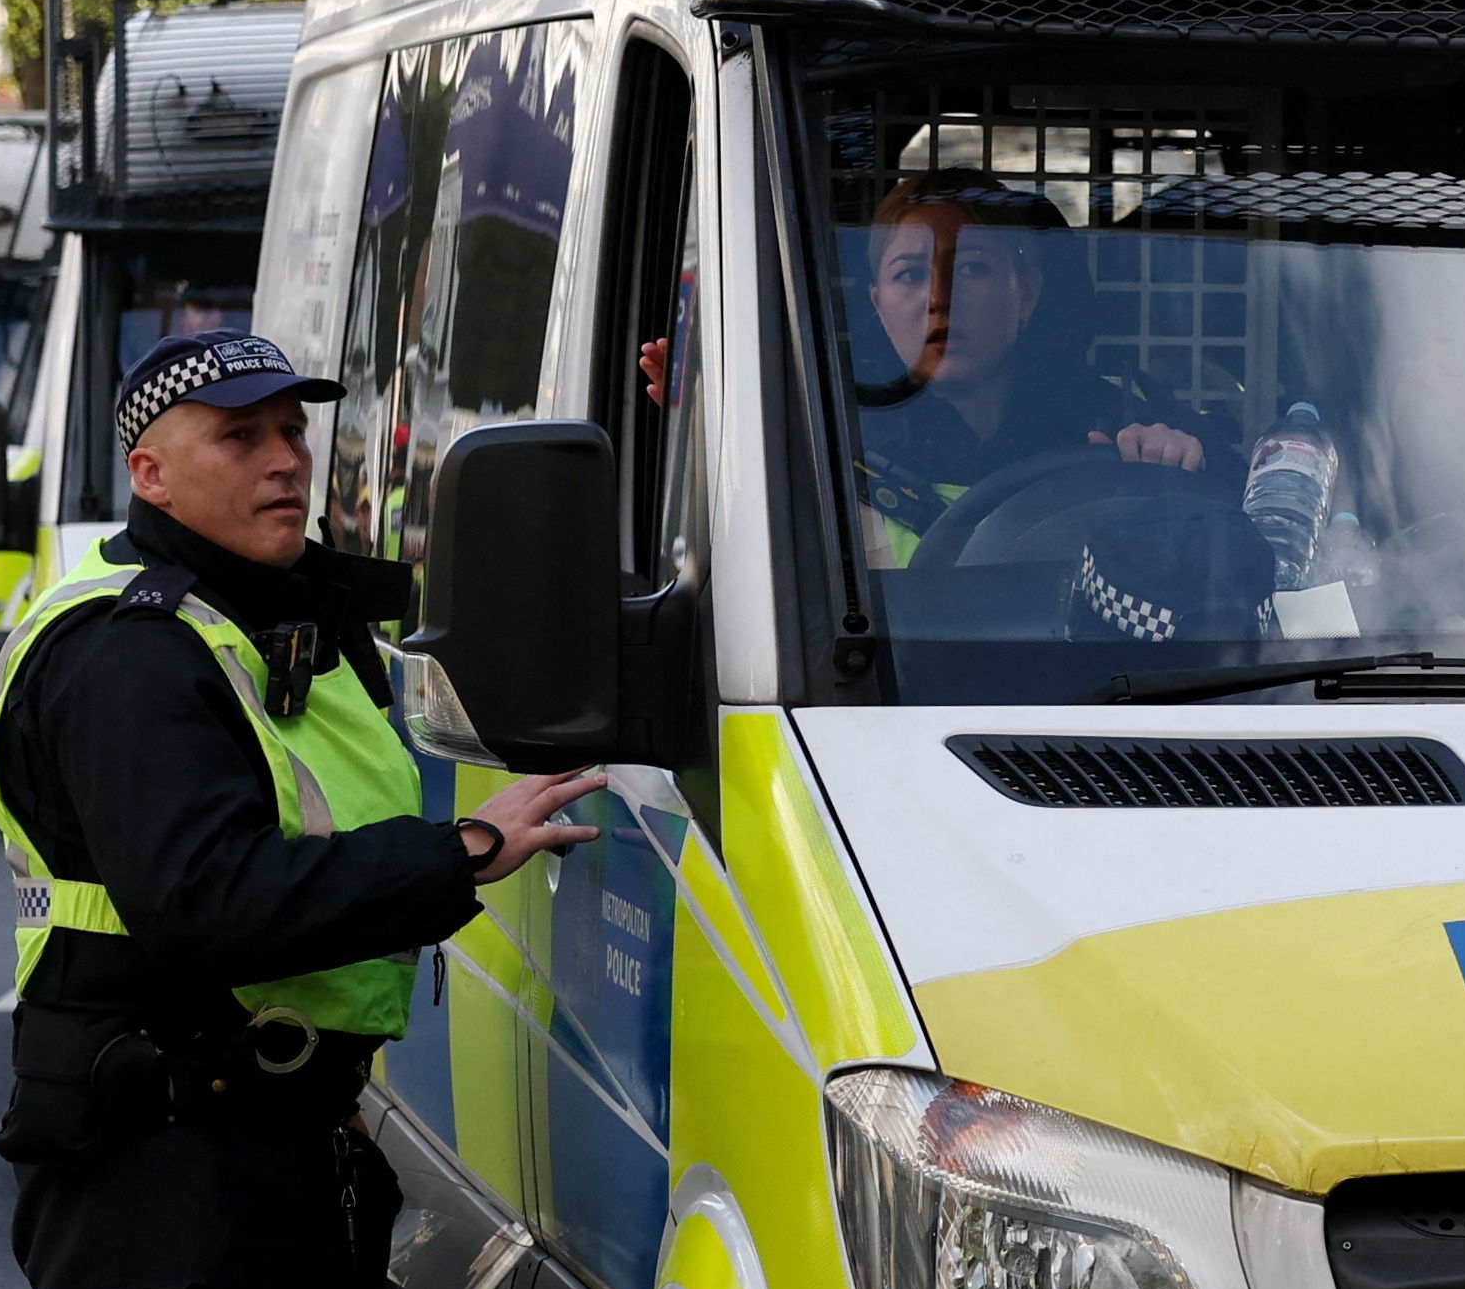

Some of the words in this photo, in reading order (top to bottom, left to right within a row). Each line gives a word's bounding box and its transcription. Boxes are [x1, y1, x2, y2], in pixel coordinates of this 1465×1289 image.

[226, 359, 262, 373] POLICE
[602, 889, 650, 943] METROPOLITAN
[606, 943, 641, 997] POLICE
